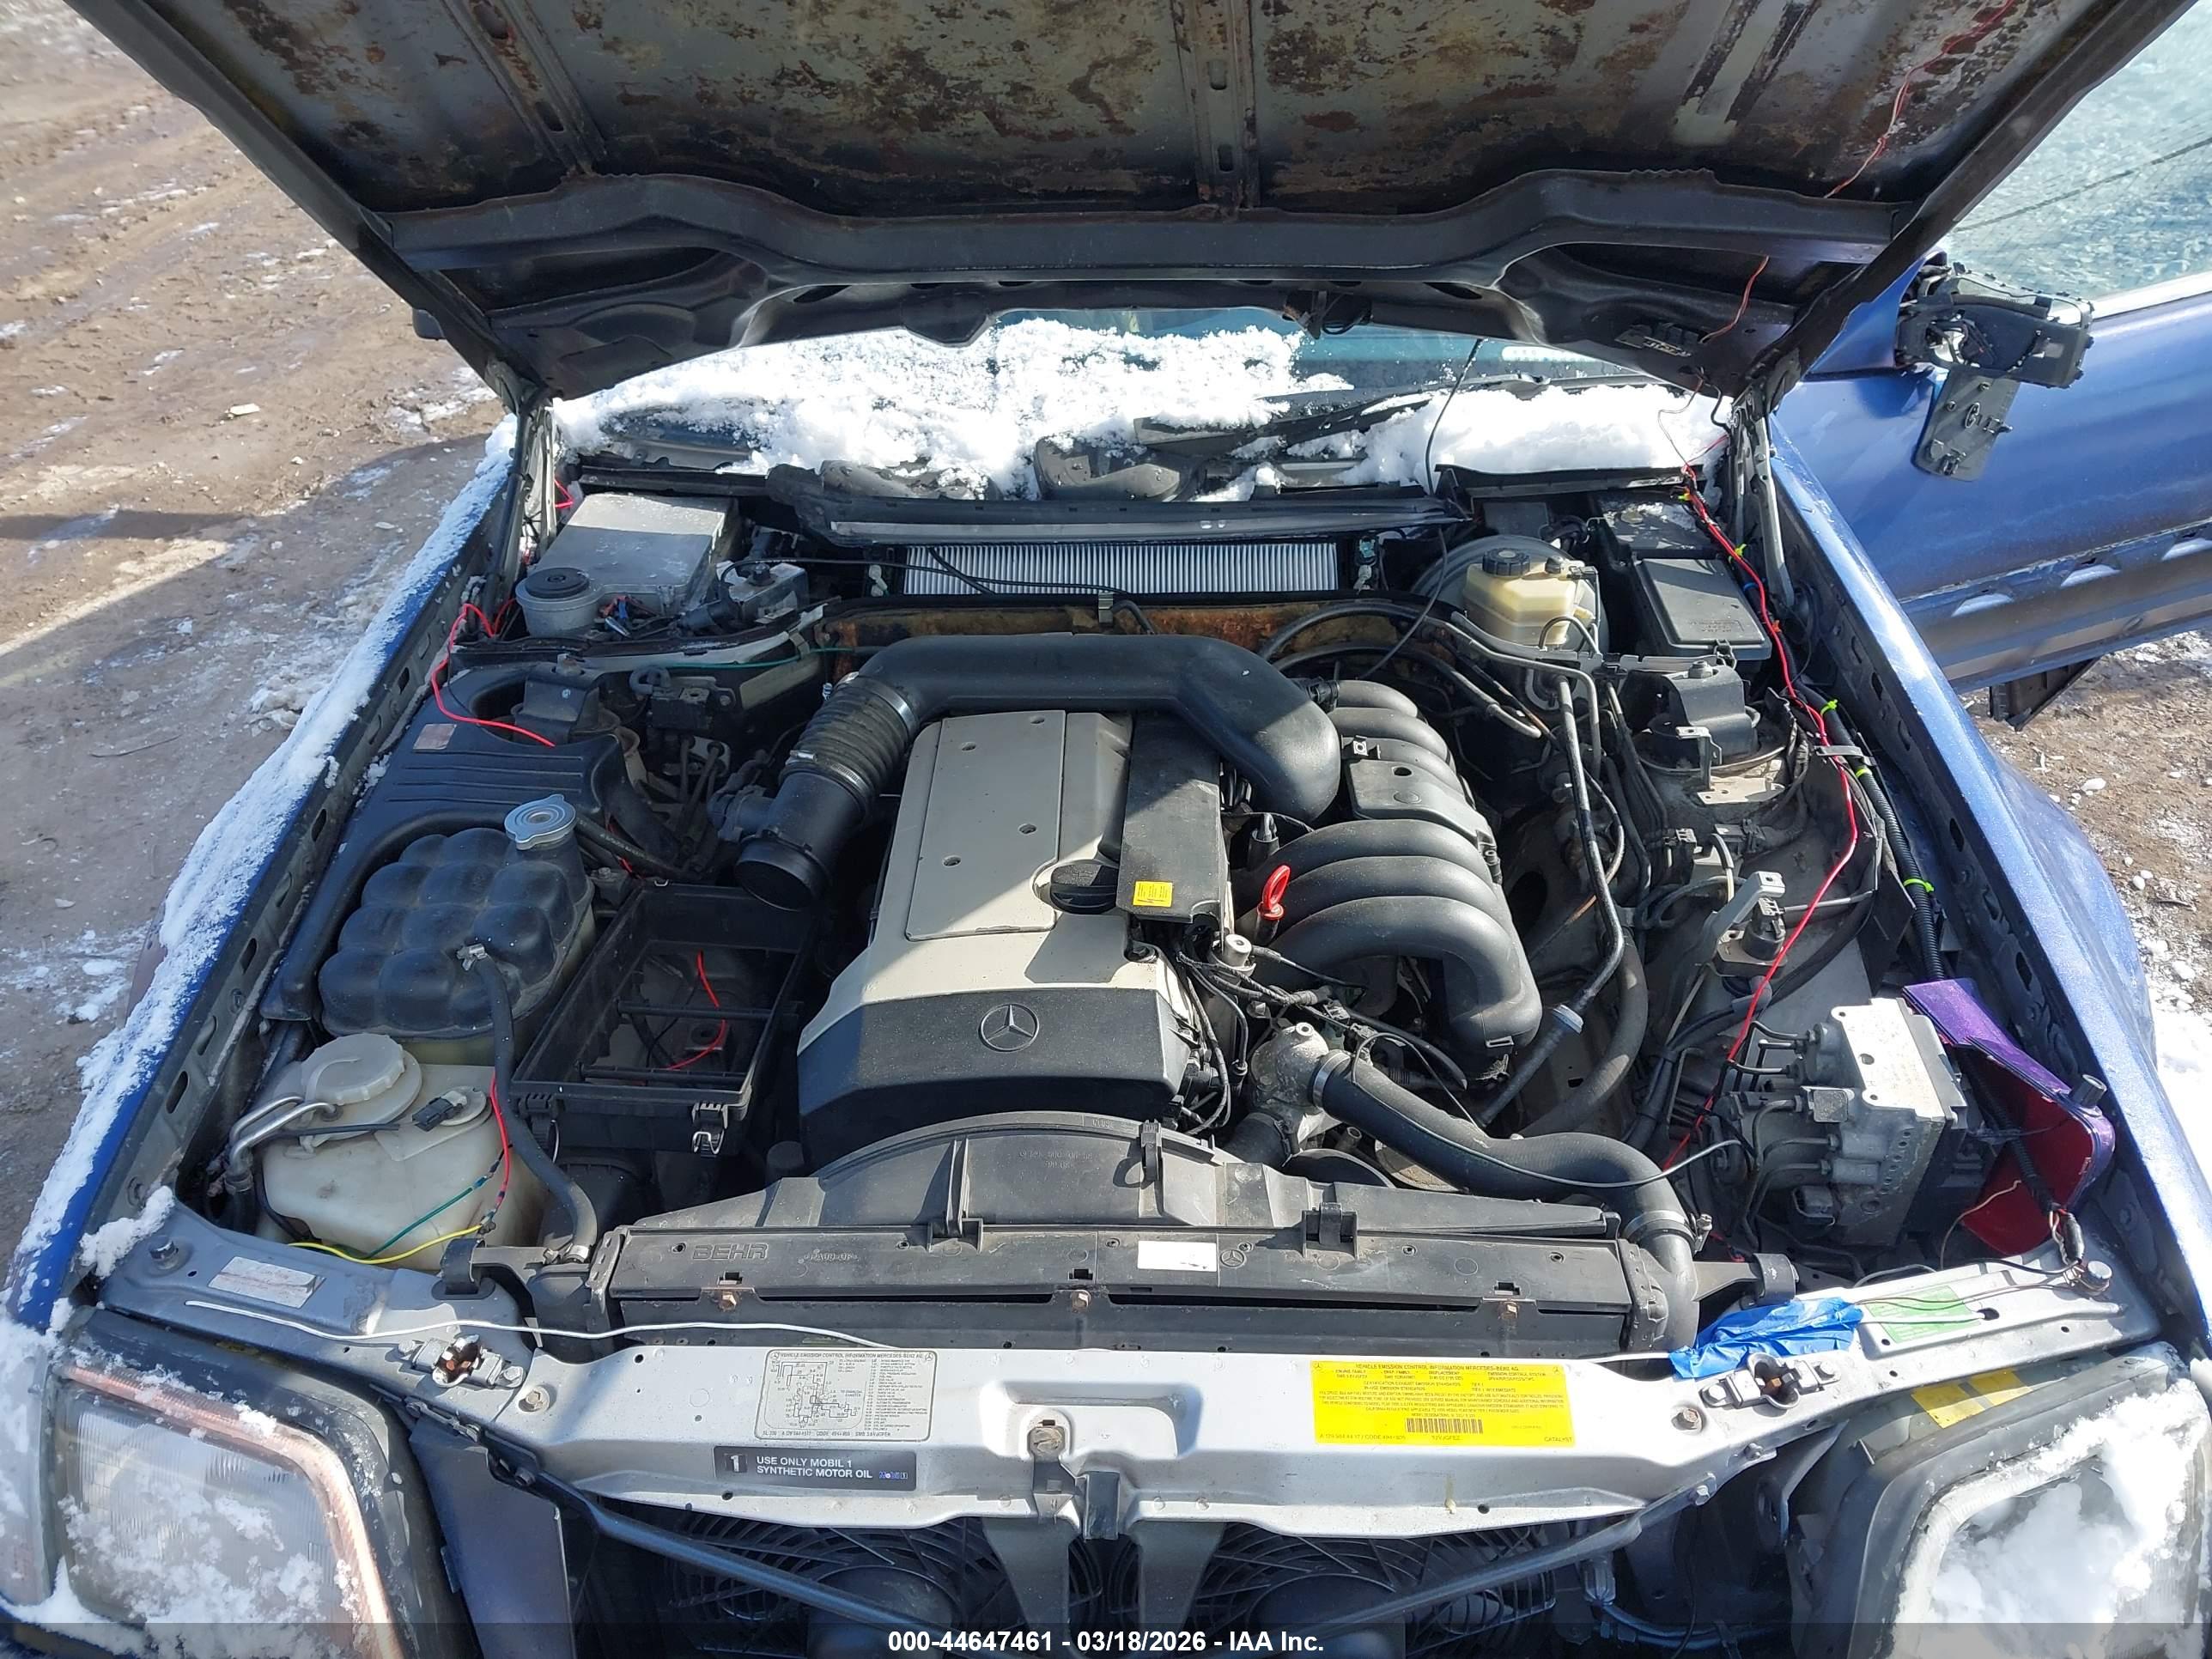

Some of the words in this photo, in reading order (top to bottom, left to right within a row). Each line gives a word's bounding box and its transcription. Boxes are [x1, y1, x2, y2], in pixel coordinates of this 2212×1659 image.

[692, 1243, 769, 1261] BEHR
[731, 1455, 739, 1472] 1
[757, 1456, 778, 1465] USE
[780, 1457, 807, 1467] ONLY
[810, 1458, 845, 1468] MOBIL
[848, 1459, 852, 1468] 1
[757, 1465, 813, 1476] SYNTHETIC
[815, 1468, 853, 1478] MOTOR
[855, 1469, 873, 1478] OIL
